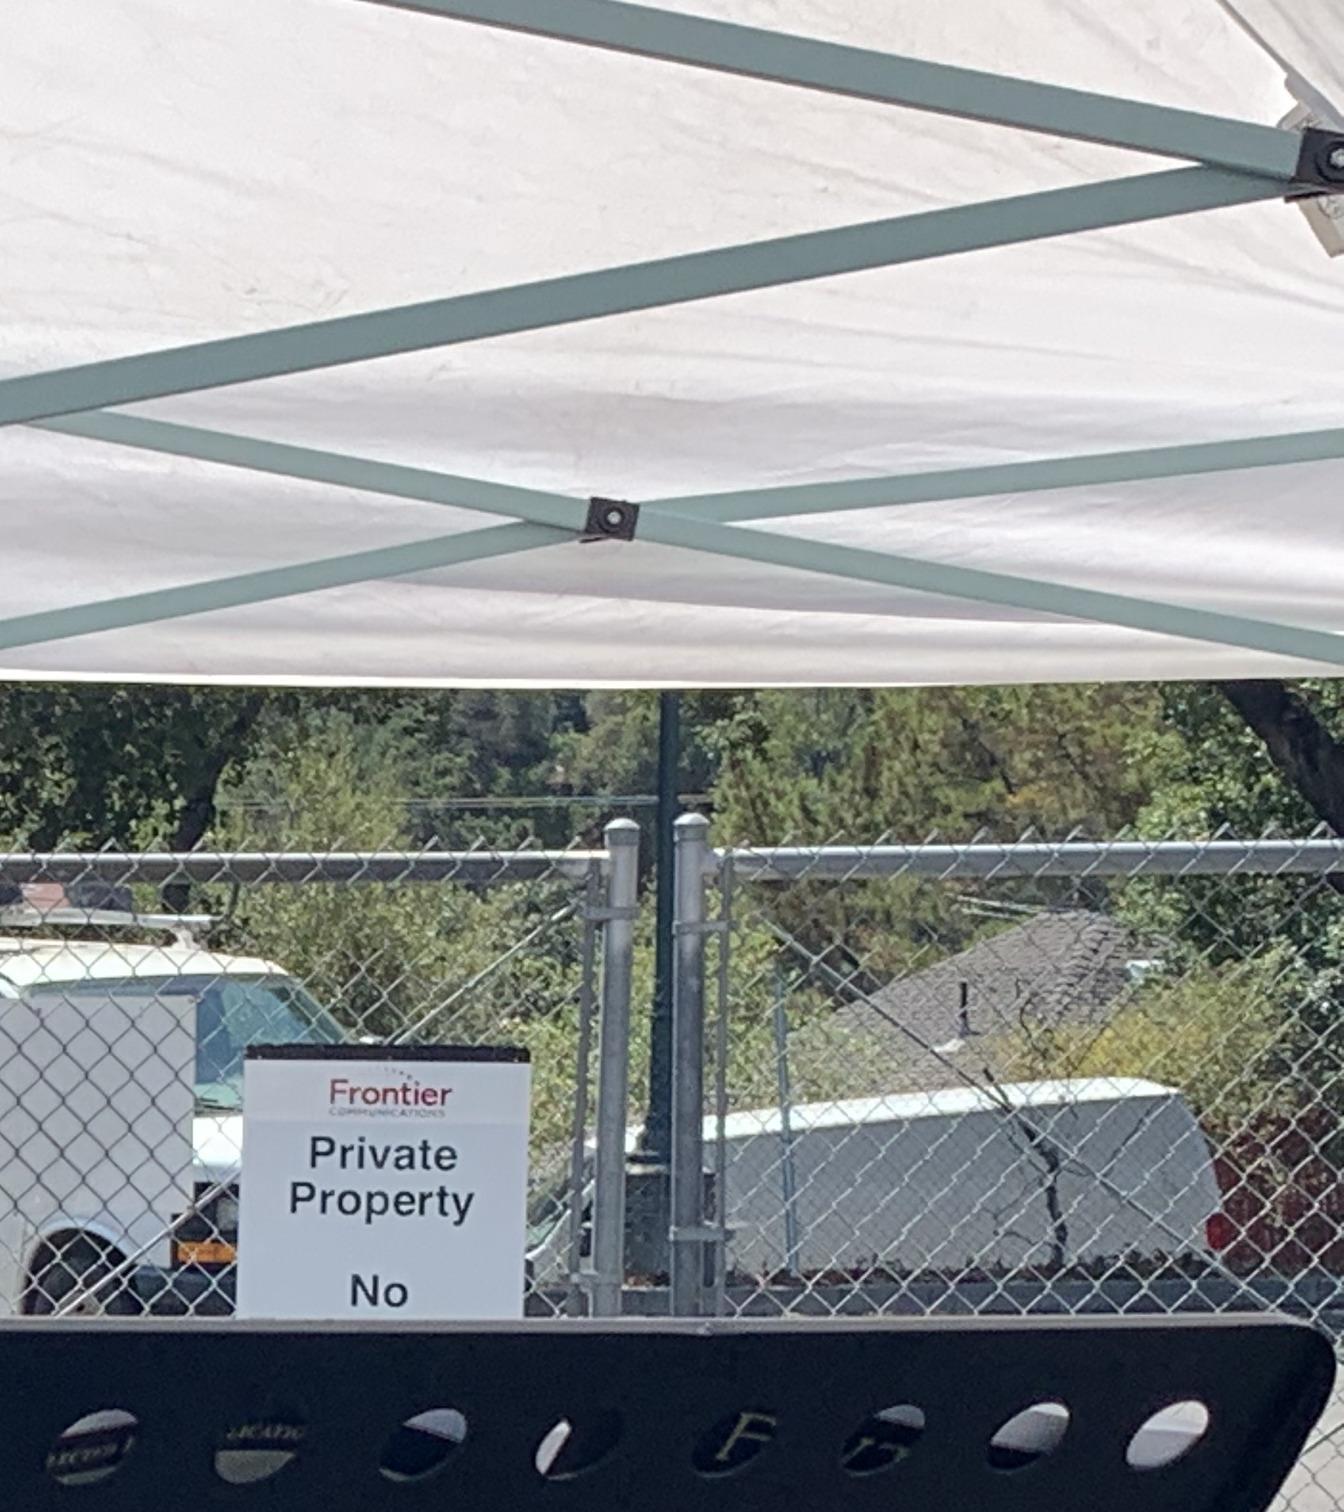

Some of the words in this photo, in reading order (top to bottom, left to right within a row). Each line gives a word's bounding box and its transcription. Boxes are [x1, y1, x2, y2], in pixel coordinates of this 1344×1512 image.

[329, 1078, 452, 1107] Frontier
[309, 1136, 458, 1172] Private
[289, 1181, 475, 1227] Property
[350, 1273, 409, 1309] No
